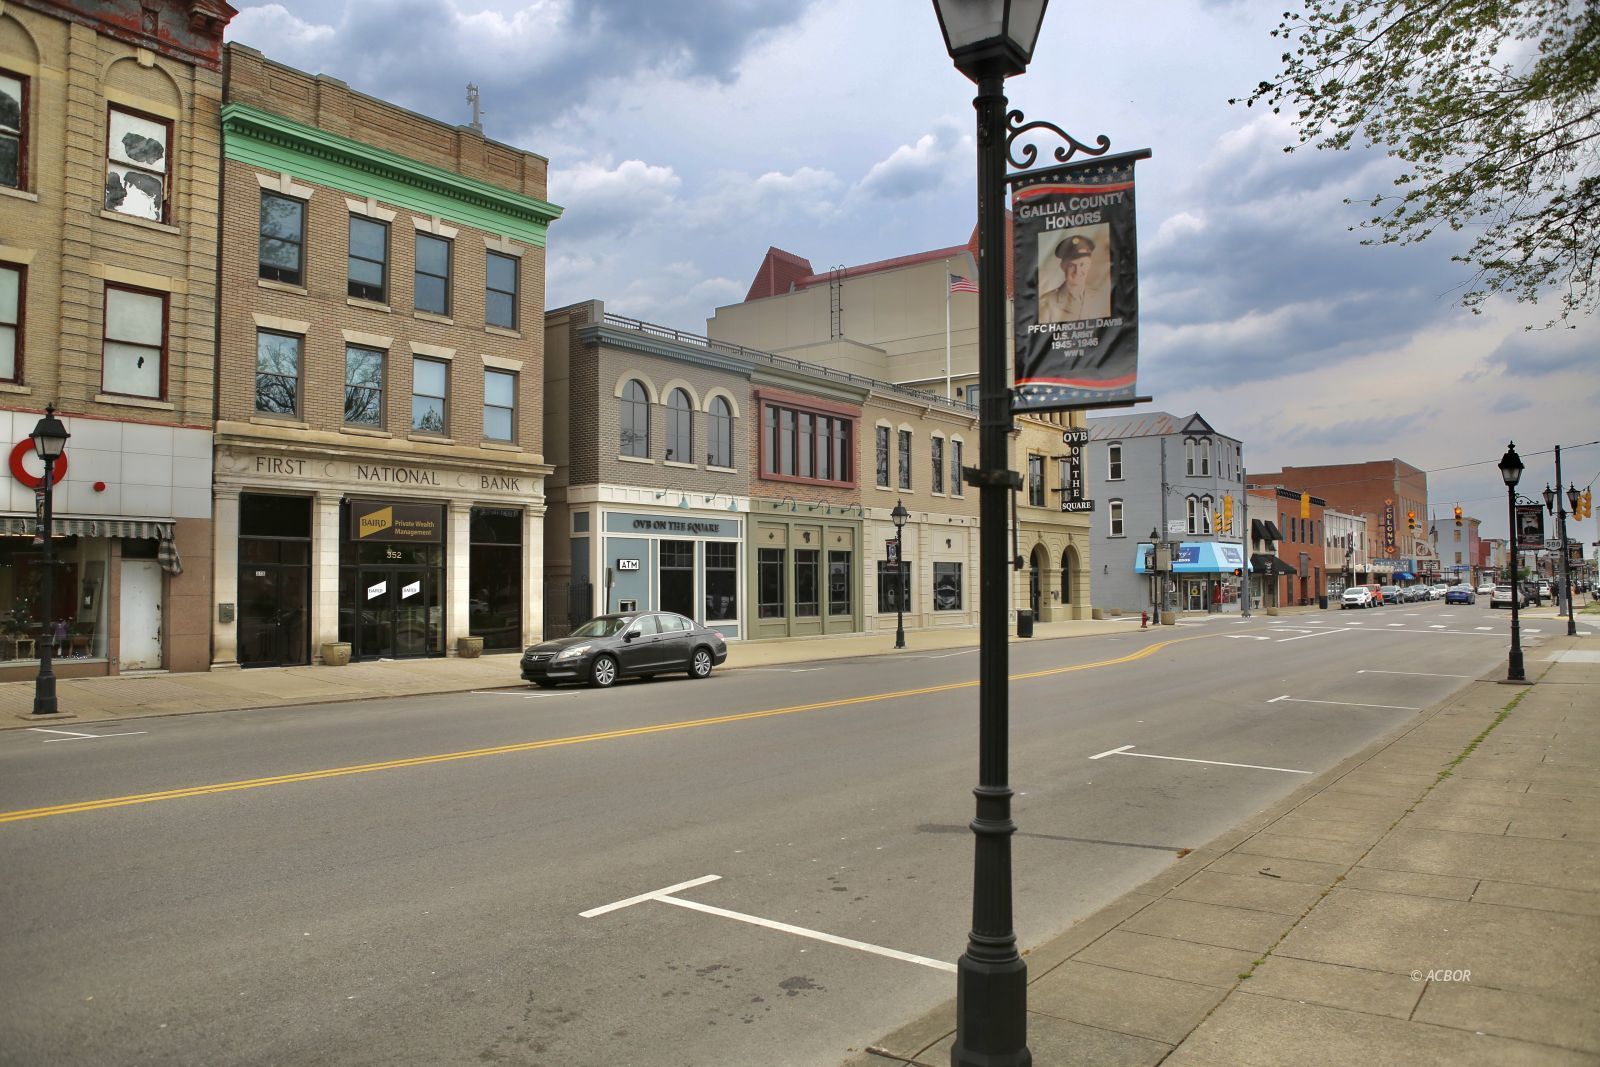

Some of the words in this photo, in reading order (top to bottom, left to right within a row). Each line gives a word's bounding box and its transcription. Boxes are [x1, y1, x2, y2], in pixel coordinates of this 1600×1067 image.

[1019, 202, 1067, 219] GALLIA
[1069, 191, 1124, 211] COUNTY
[1045, 211, 1102, 230] HONORS
[1027, 324, 1048, 334] PFC
[1048, 321, 1085, 332] HAROLD
[1096, 318, 1123, 328] DAVIS
[1053, 332, 1070, 341] U.S.
[1071, 331, 1095, 339] ARMY
[1063, 431, 1088, 442] OVB
[1072, 446, 1080, 466] ON
[255, 456, 307, 476] FIRST
[357, 465, 441, 486] NATIONAL
[481, 475, 521, 491] BANK
[1072, 470, 1081, 497] THE
[1062, 501, 1092, 511] SQUARE
[361, 518, 387, 528] BAIRD
[632, 519, 652, 530] OVB
[653, 520, 667, 530] ON
[668, 521, 686, 531] THE
[687, 522, 721, 534] SQUARE
[1386, 507, 1394, 544] COLONY
[394, 528, 432, 537] Management
[386, 551, 402, 559] 352
[621, 560, 638, 569] ATM
